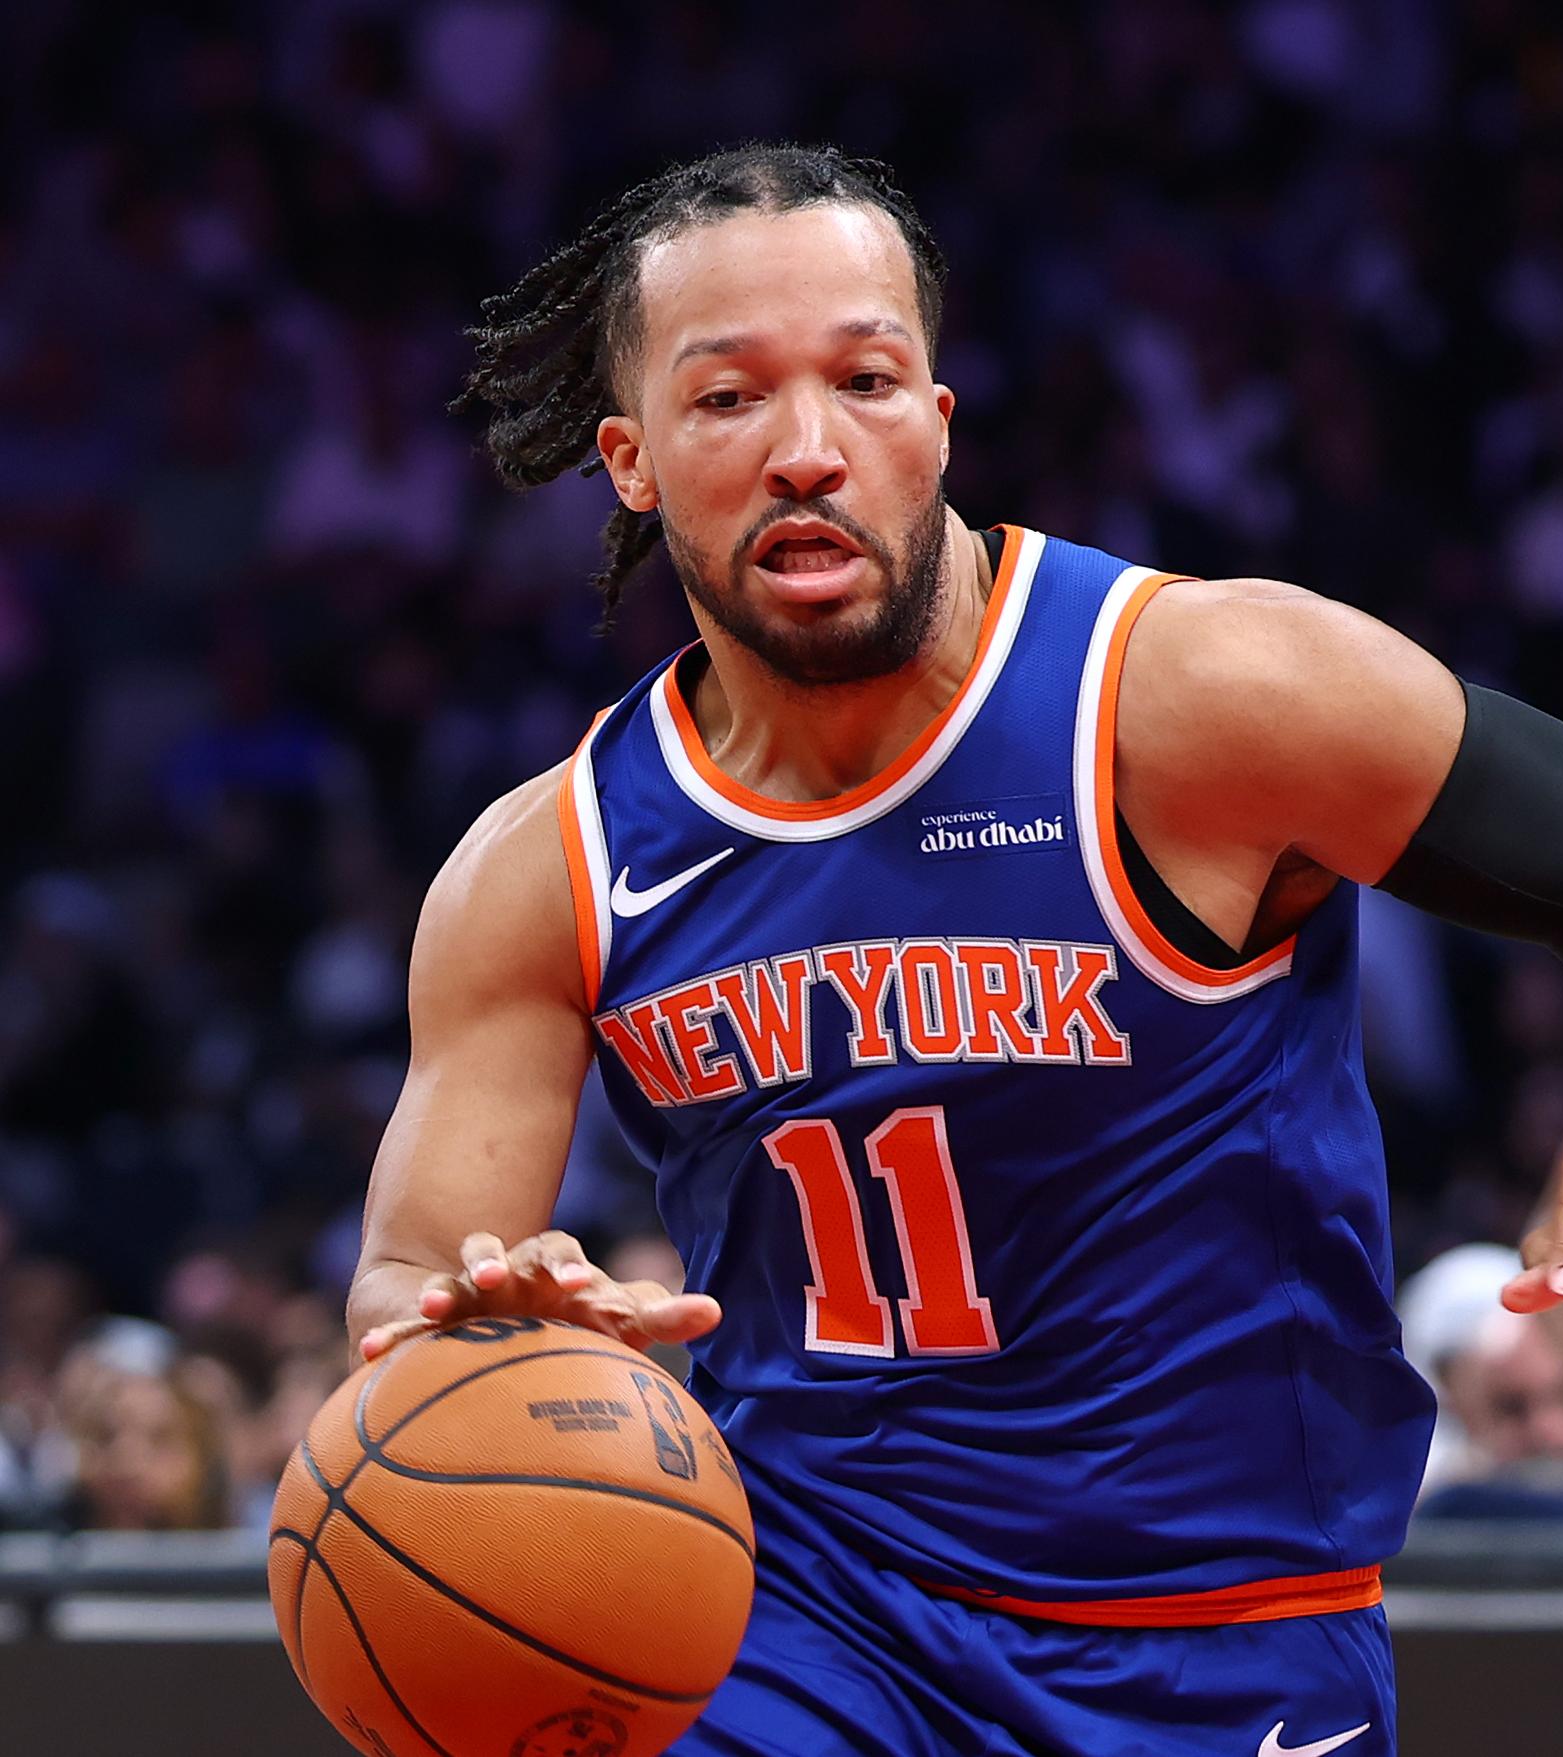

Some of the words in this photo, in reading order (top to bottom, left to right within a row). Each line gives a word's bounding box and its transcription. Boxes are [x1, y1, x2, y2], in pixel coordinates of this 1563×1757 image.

[920, 828, 975, 852] abu
[921, 810, 997, 827] experience
[594, 948, 812, 1107] NEW
[816, 937, 1131, 1066] YORK
[761, 1105, 1000, 1358] 11
